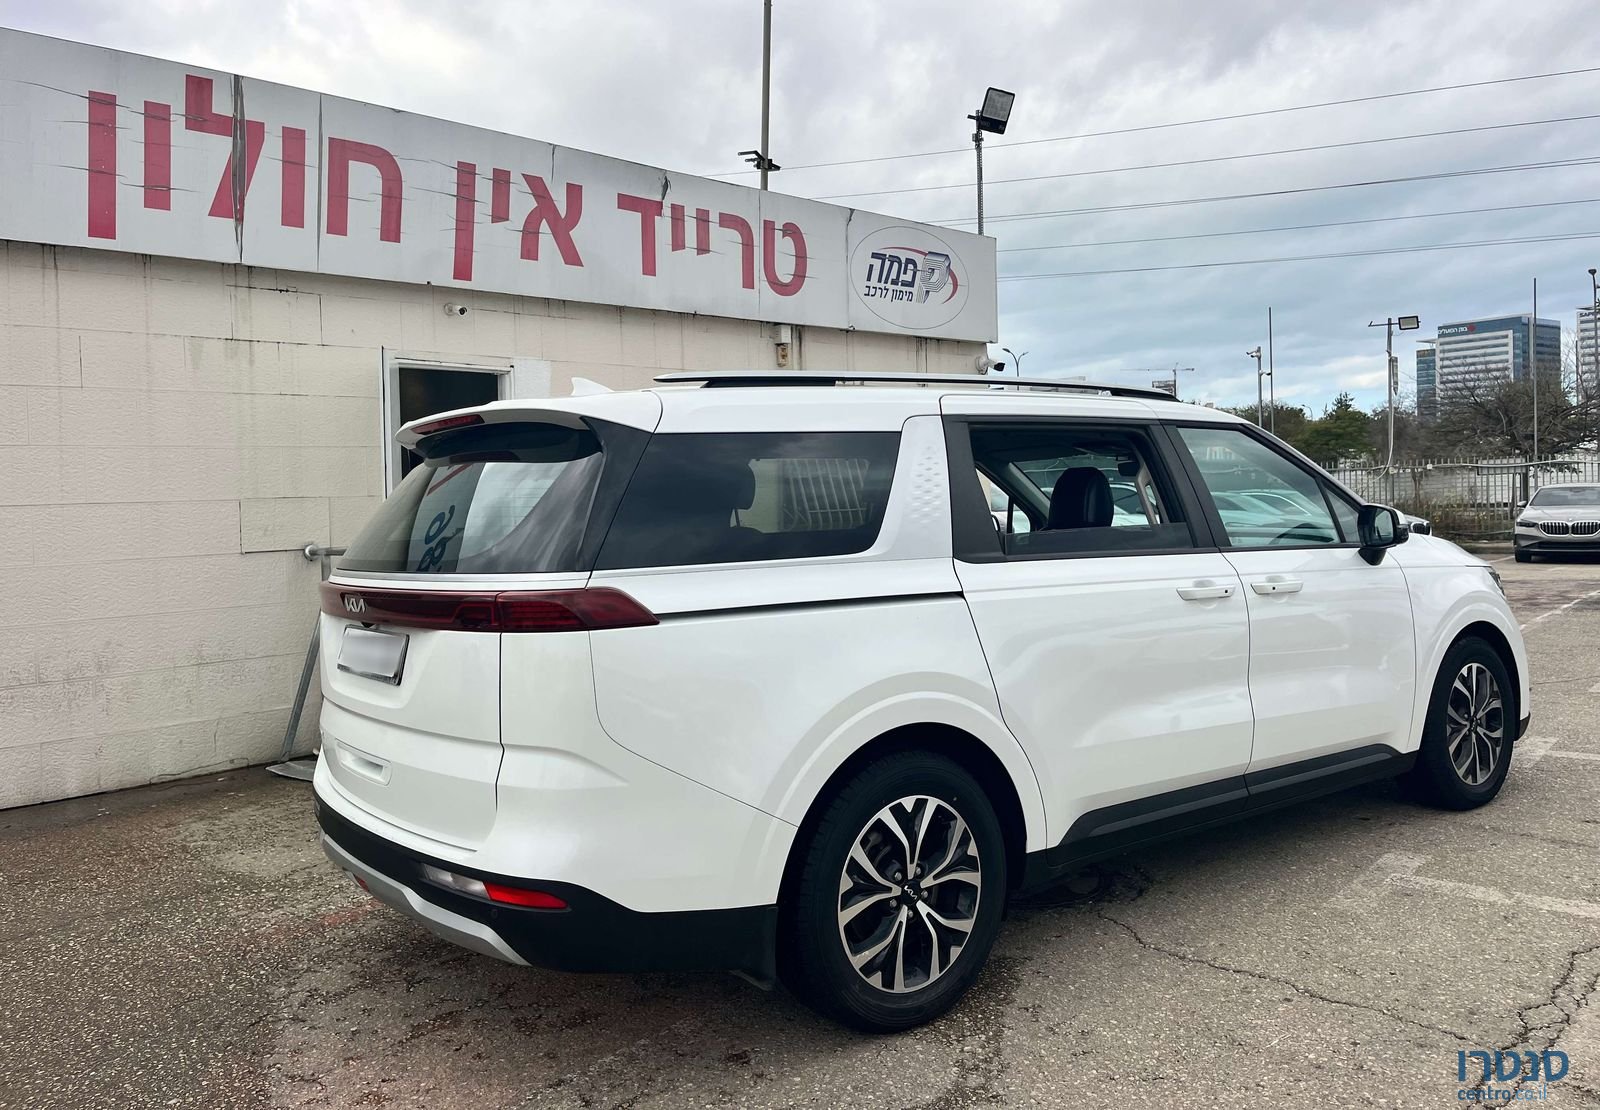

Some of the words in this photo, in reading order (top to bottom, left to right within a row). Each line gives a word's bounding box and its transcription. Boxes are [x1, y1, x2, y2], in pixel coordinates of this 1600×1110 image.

[88, 74, 403, 243] חולון
[453, 161, 584, 281] אין
[617, 193, 807, 296] טרייד
[864, 285, 889, 299] לרכב
[866, 252, 918, 288] פמה
[890, 289, 913, 302] מימון
